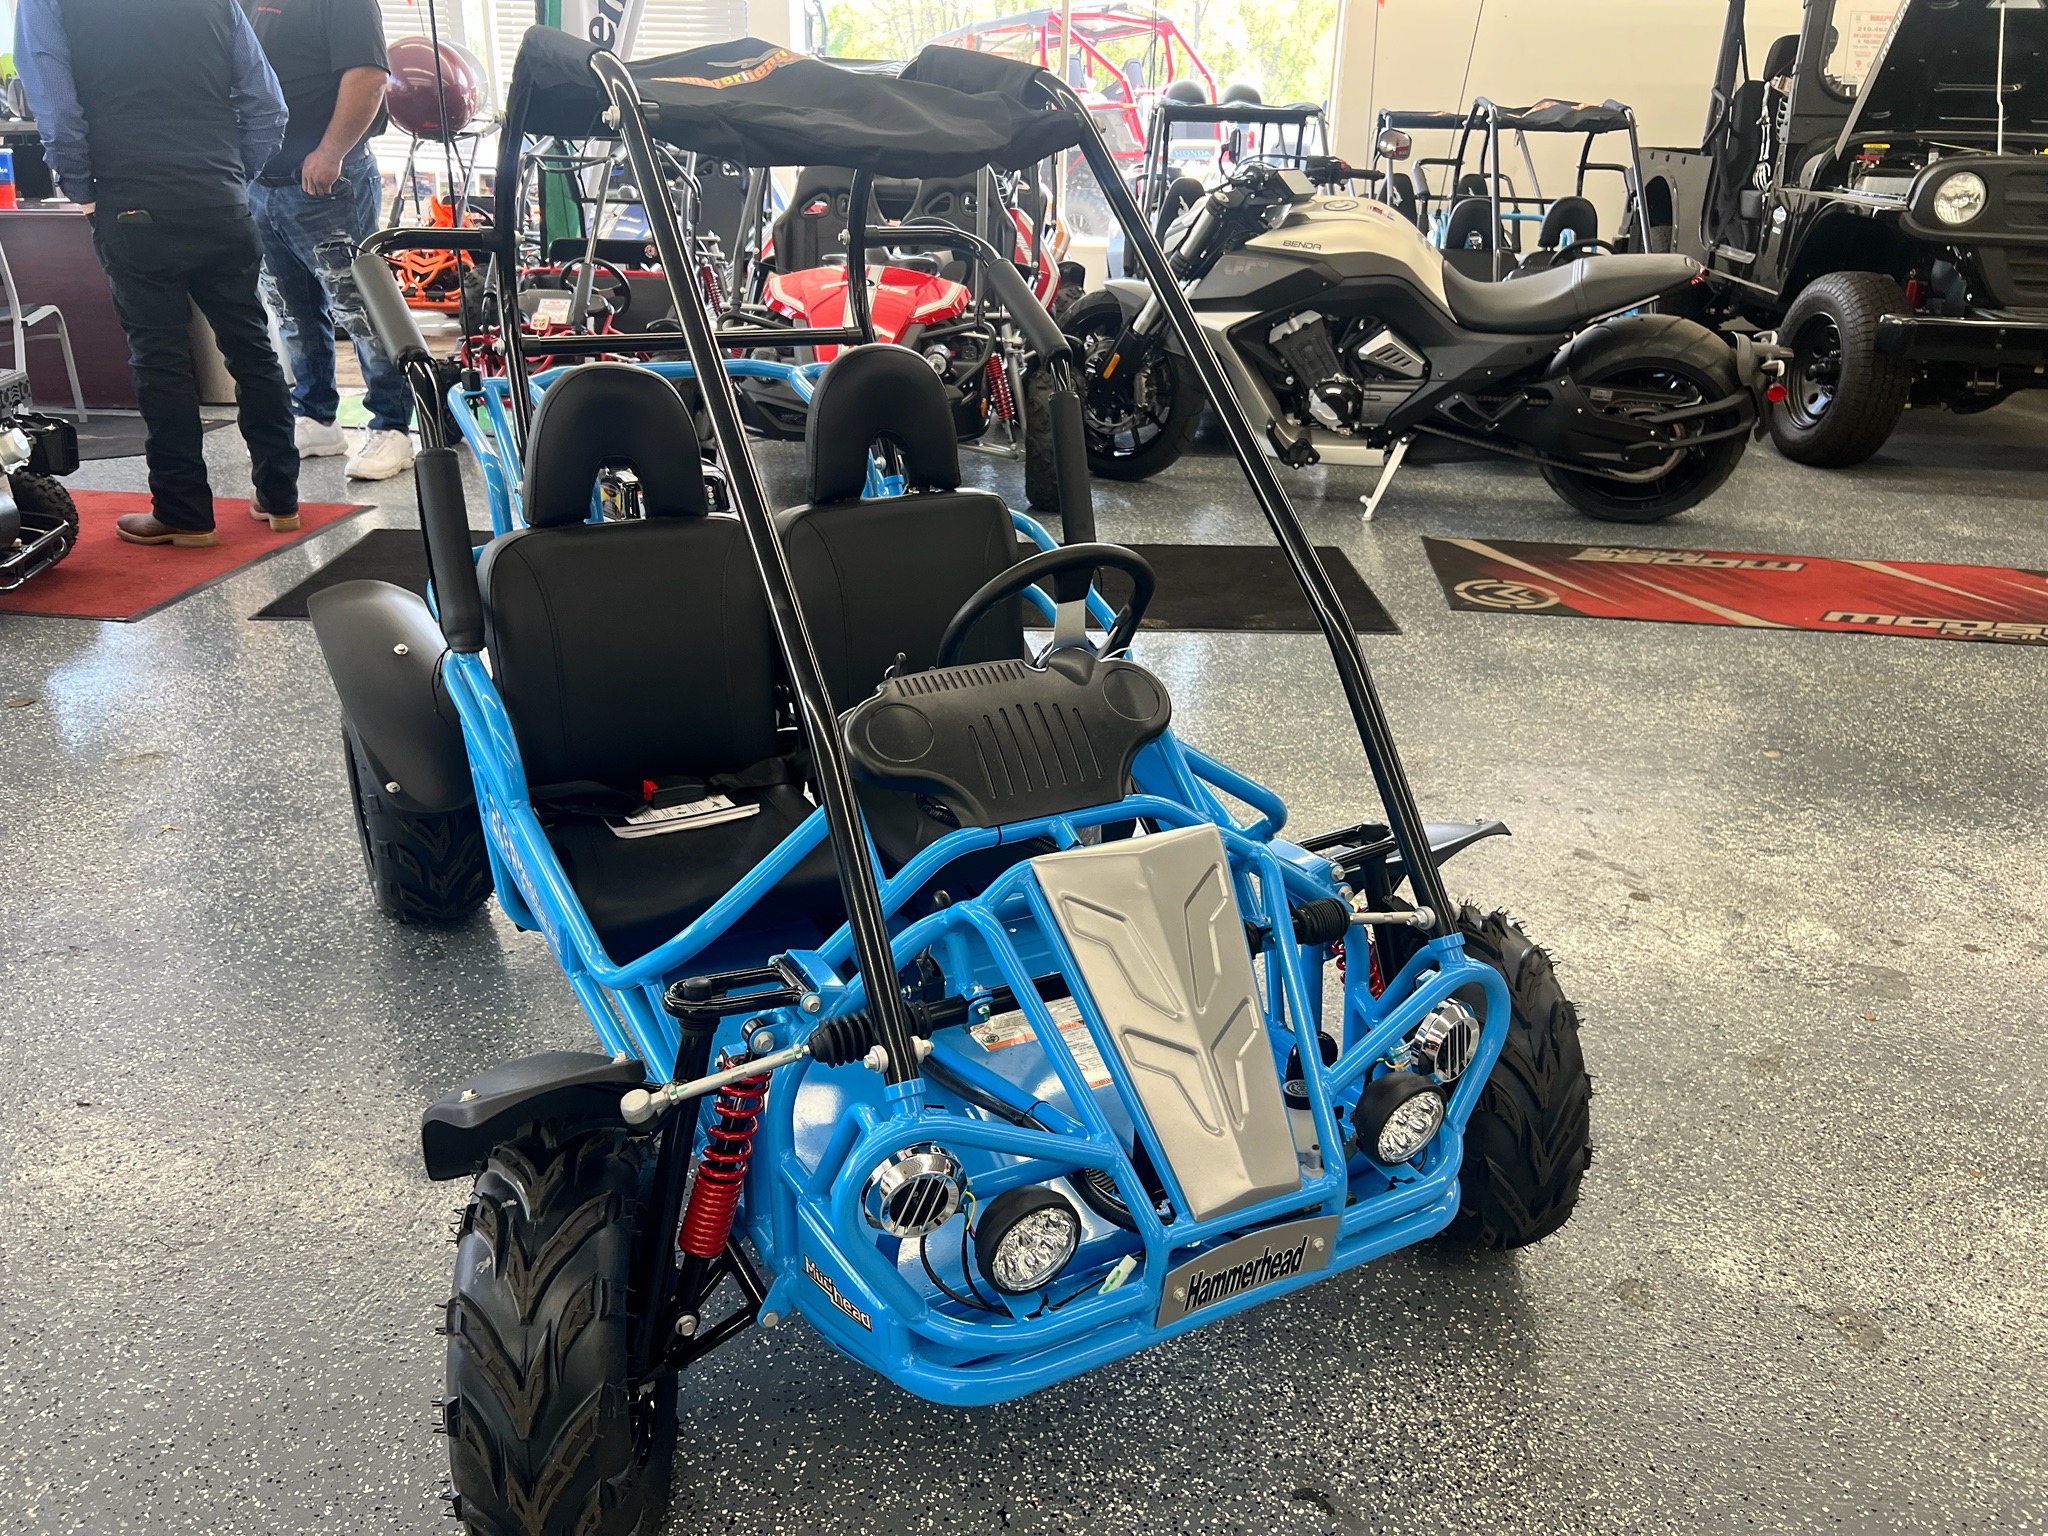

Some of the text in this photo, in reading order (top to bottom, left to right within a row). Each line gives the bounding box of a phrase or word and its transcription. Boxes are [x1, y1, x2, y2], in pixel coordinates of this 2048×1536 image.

[1174, 149, 1211, 158] HONDA
[1282, 240, 1322, 251] BENDA
[1568, 549, 1806, 572] MOOSE
[1821, 611, 2048, 638] MOOS
[1184, 1235, 1309, 1311] Hammerhead
[803, 1253, 872, 1332] Mudhead
